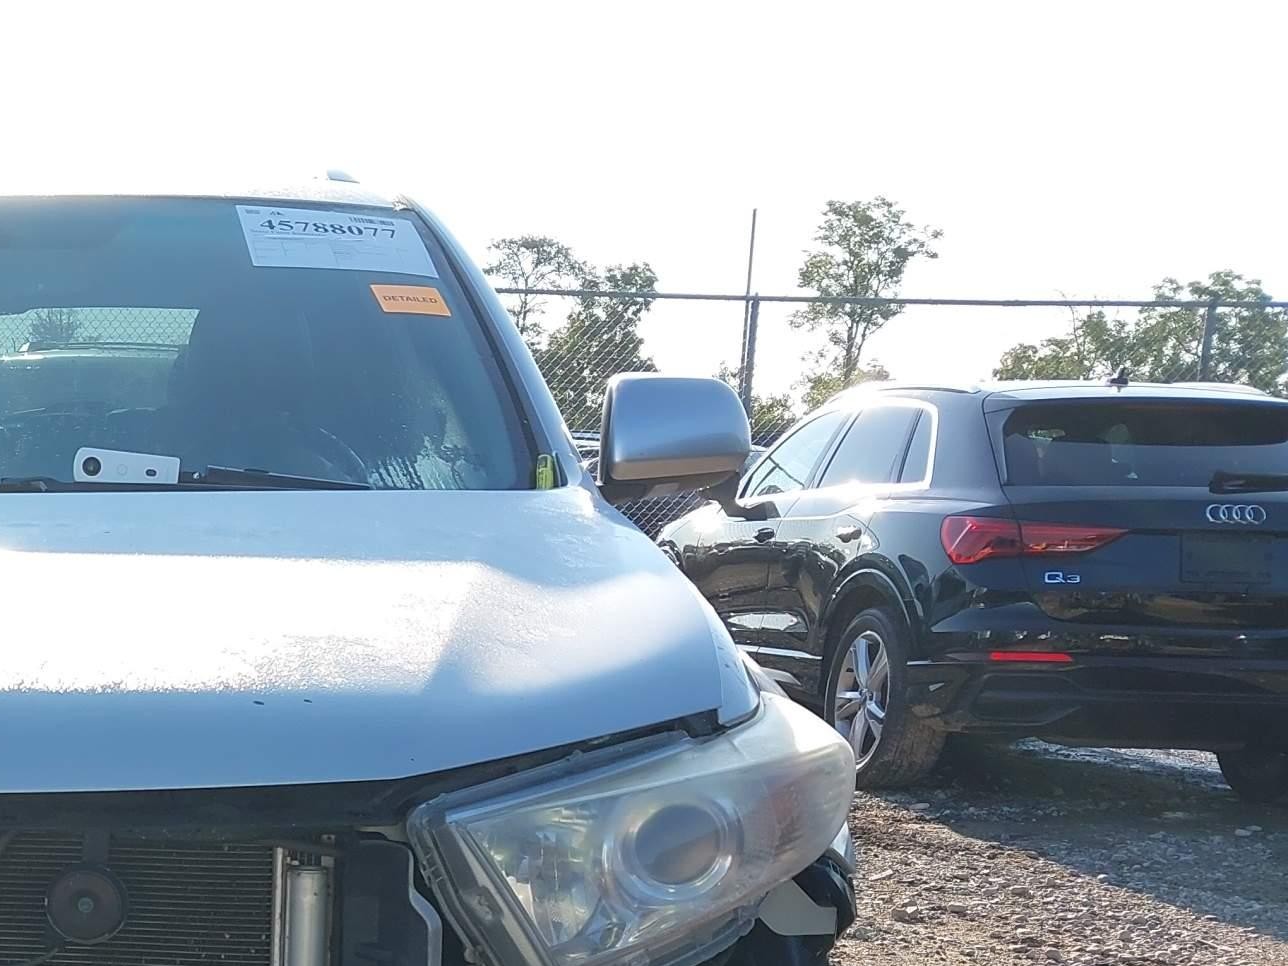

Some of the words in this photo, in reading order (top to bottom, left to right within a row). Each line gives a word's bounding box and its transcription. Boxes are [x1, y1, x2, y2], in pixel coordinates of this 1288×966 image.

[259, 219, 397, 239] 45788077
[382, 295, 439, 304] DETAILED
[1044, 571, 1081, 584] Q3
